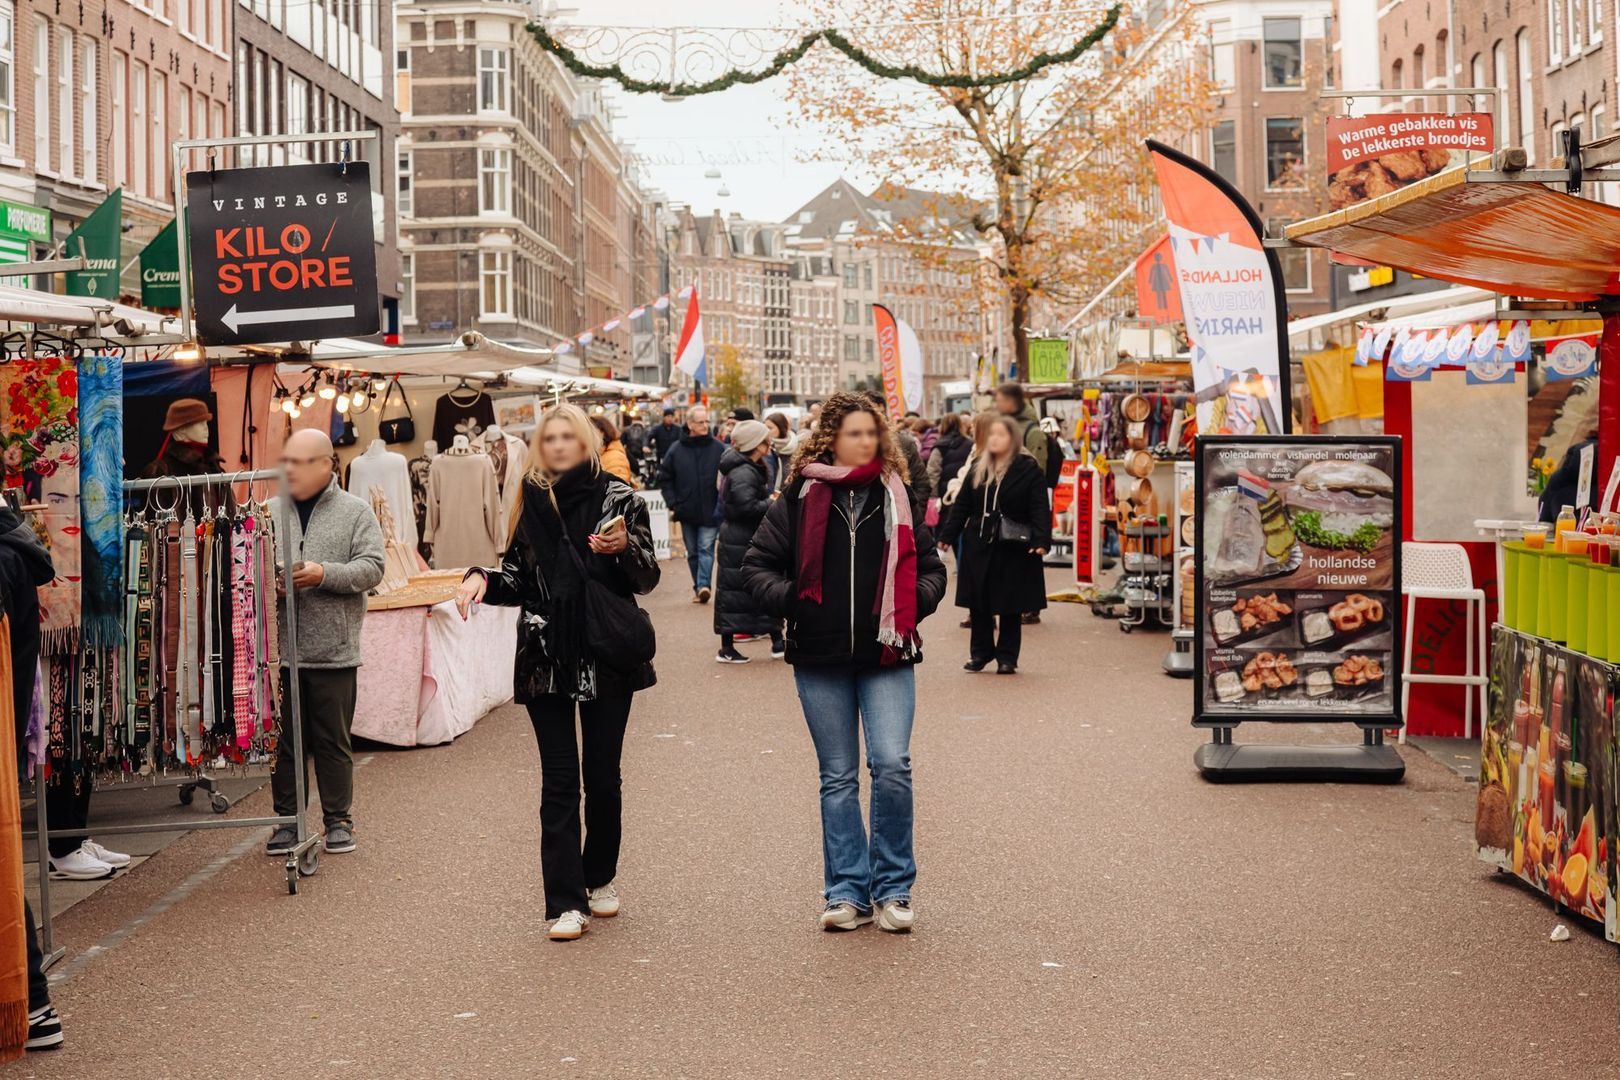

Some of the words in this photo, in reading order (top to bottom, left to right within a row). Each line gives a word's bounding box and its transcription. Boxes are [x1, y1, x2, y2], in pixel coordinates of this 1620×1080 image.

[1338, 125, 1385, 145] Warme
[1389, 116, 1455, 136] gebakken
[1459, 117, 1478, 129] vis
[1342, 148, 1360, 161] De
[1362, 134, 1425, 155] lekkerste
[1428, 132, 1487, 148] broodjes
[213, 192, 348, 212] VINTAGE
[215, 223, 312, 259] KILO
[85, 257, 117, 270] ema
[143, 268, 180, 283] Crem
[217, 256, 353, 295] STORE
[1219, 450, 1281, 460] volendammer
[1287, 450, 1329, 460] vishandel
[1335, 450, 1378, 460] molenaar
[1309, 556, 1377, 569] hollandse
[1317, 573, 1368, 585] nieuwe
